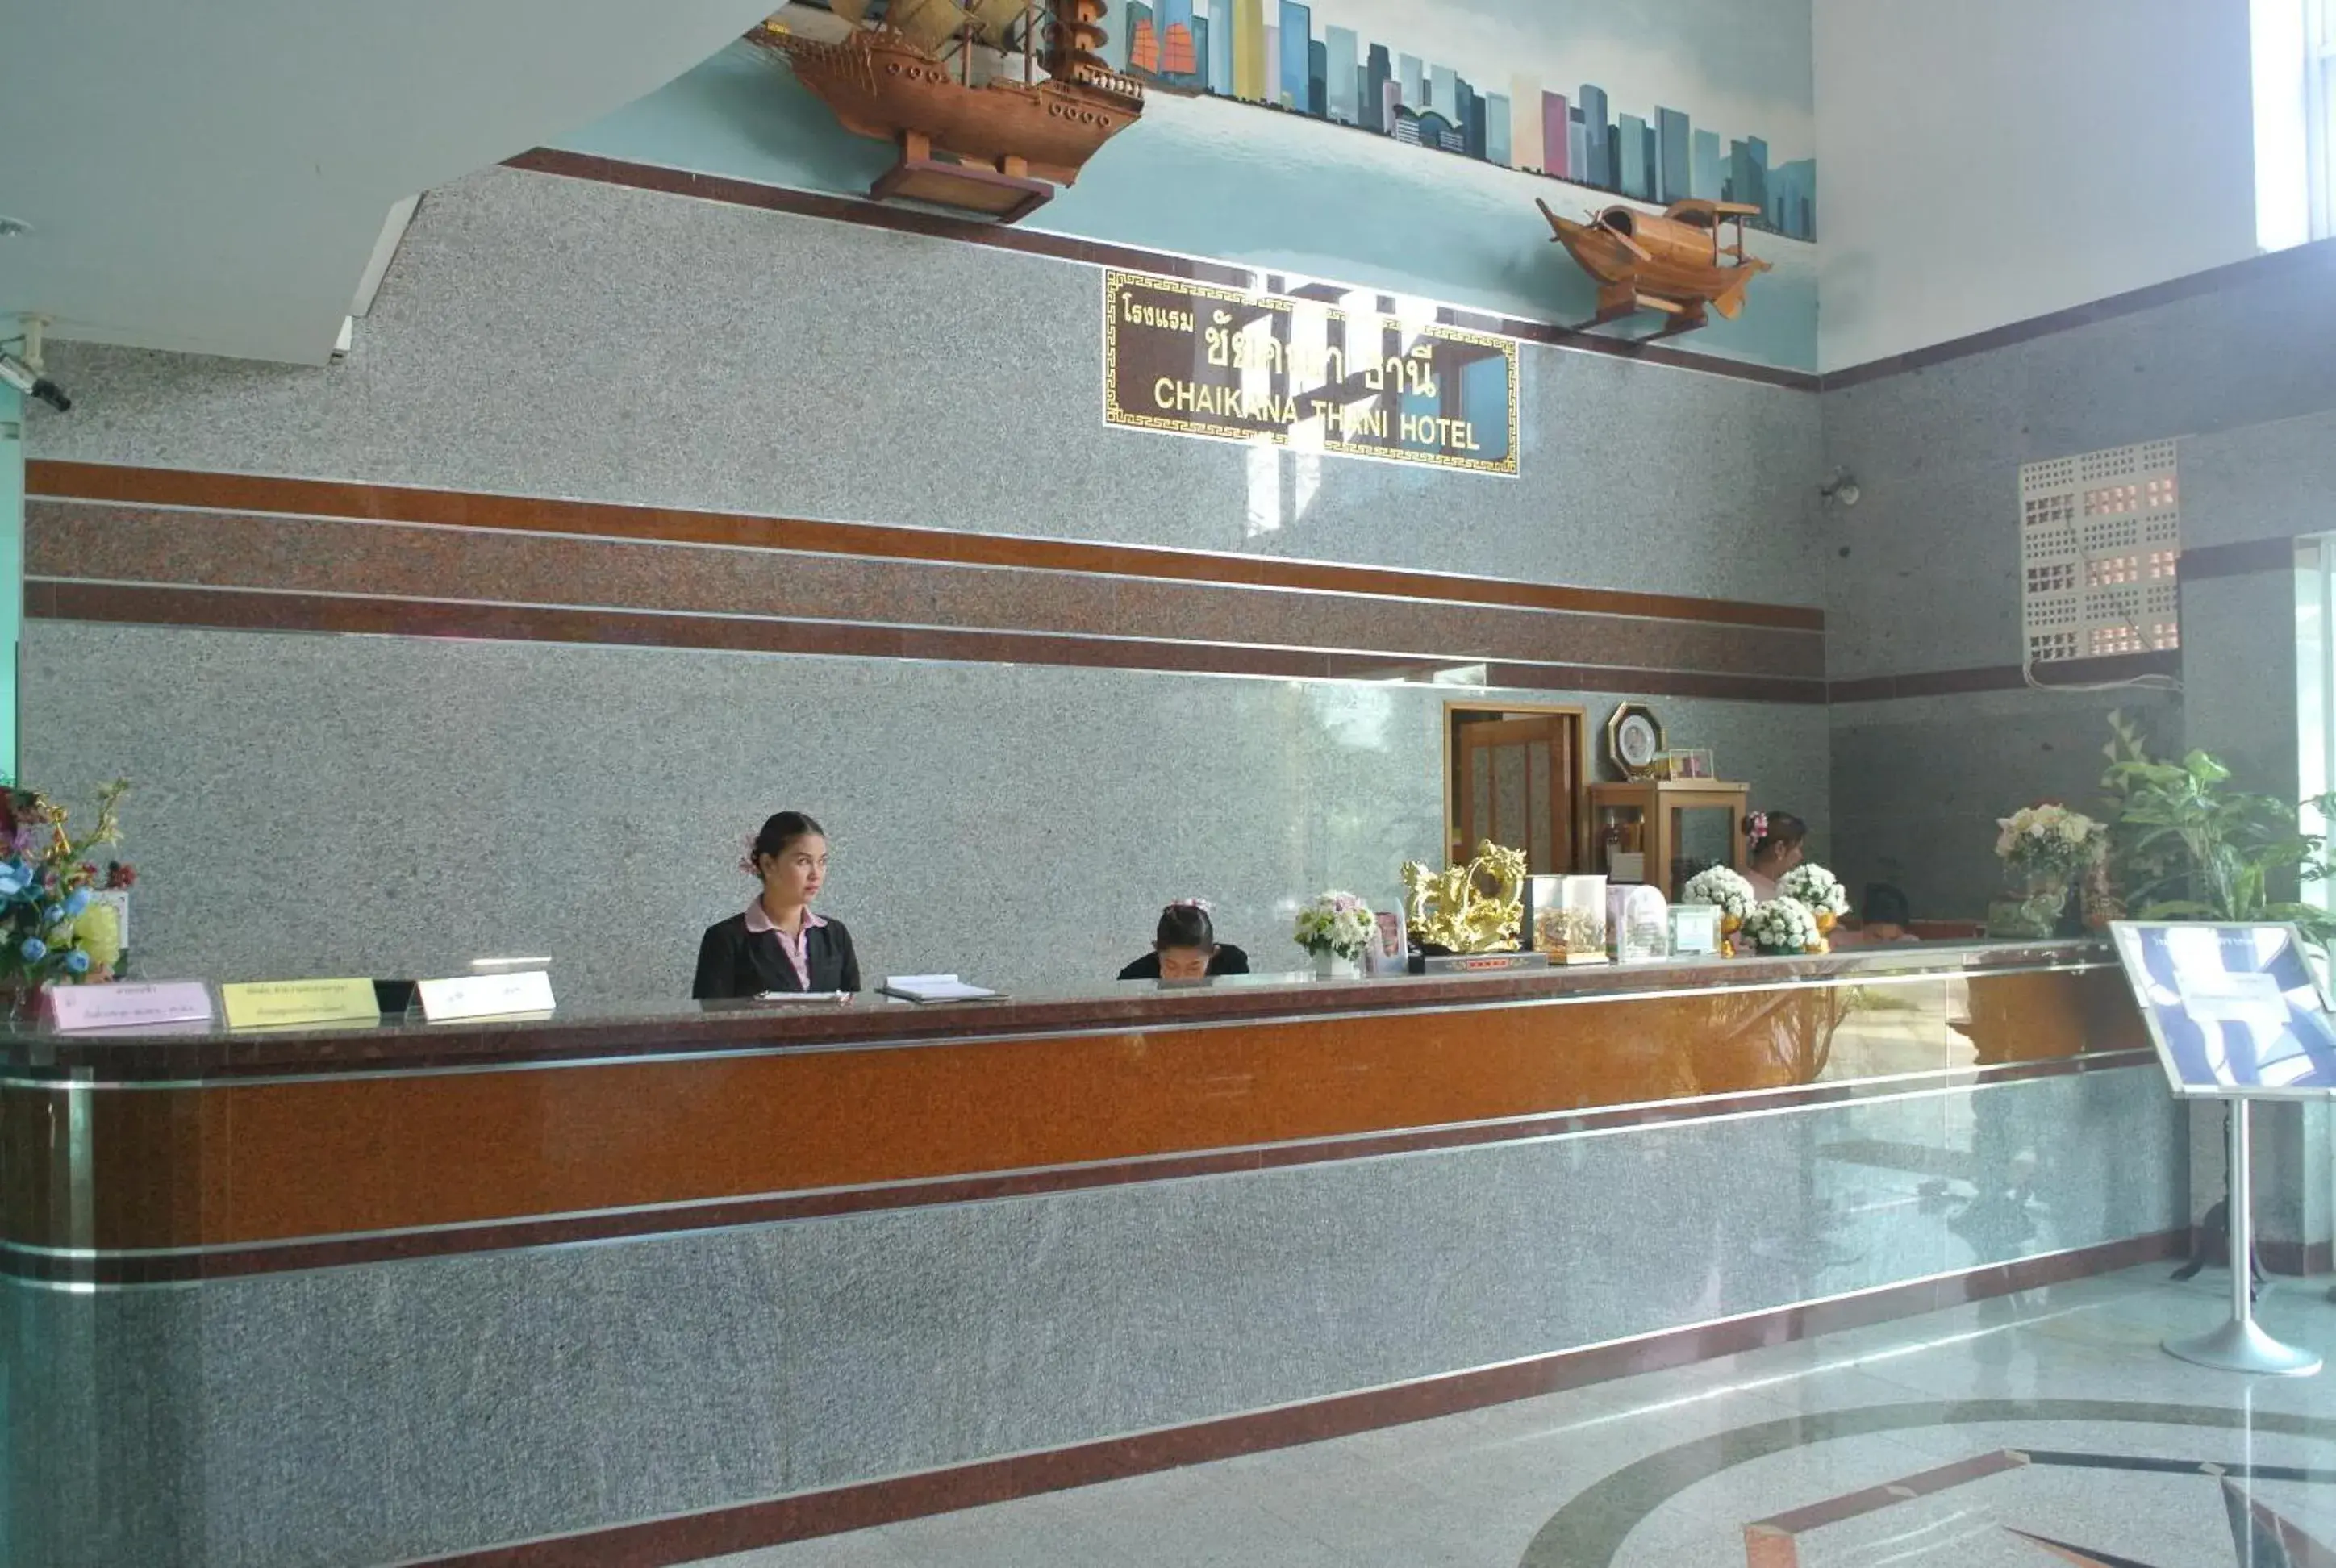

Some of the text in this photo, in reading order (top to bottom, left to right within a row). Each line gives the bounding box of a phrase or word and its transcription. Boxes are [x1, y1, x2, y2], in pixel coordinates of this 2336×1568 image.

[1122, 292, 1194, 332] โรงแรม
[1204, 308, 1344, 384] ชัยคา
[1153, 377, 1480, 450] CHAIKANA THANI HOTEL
